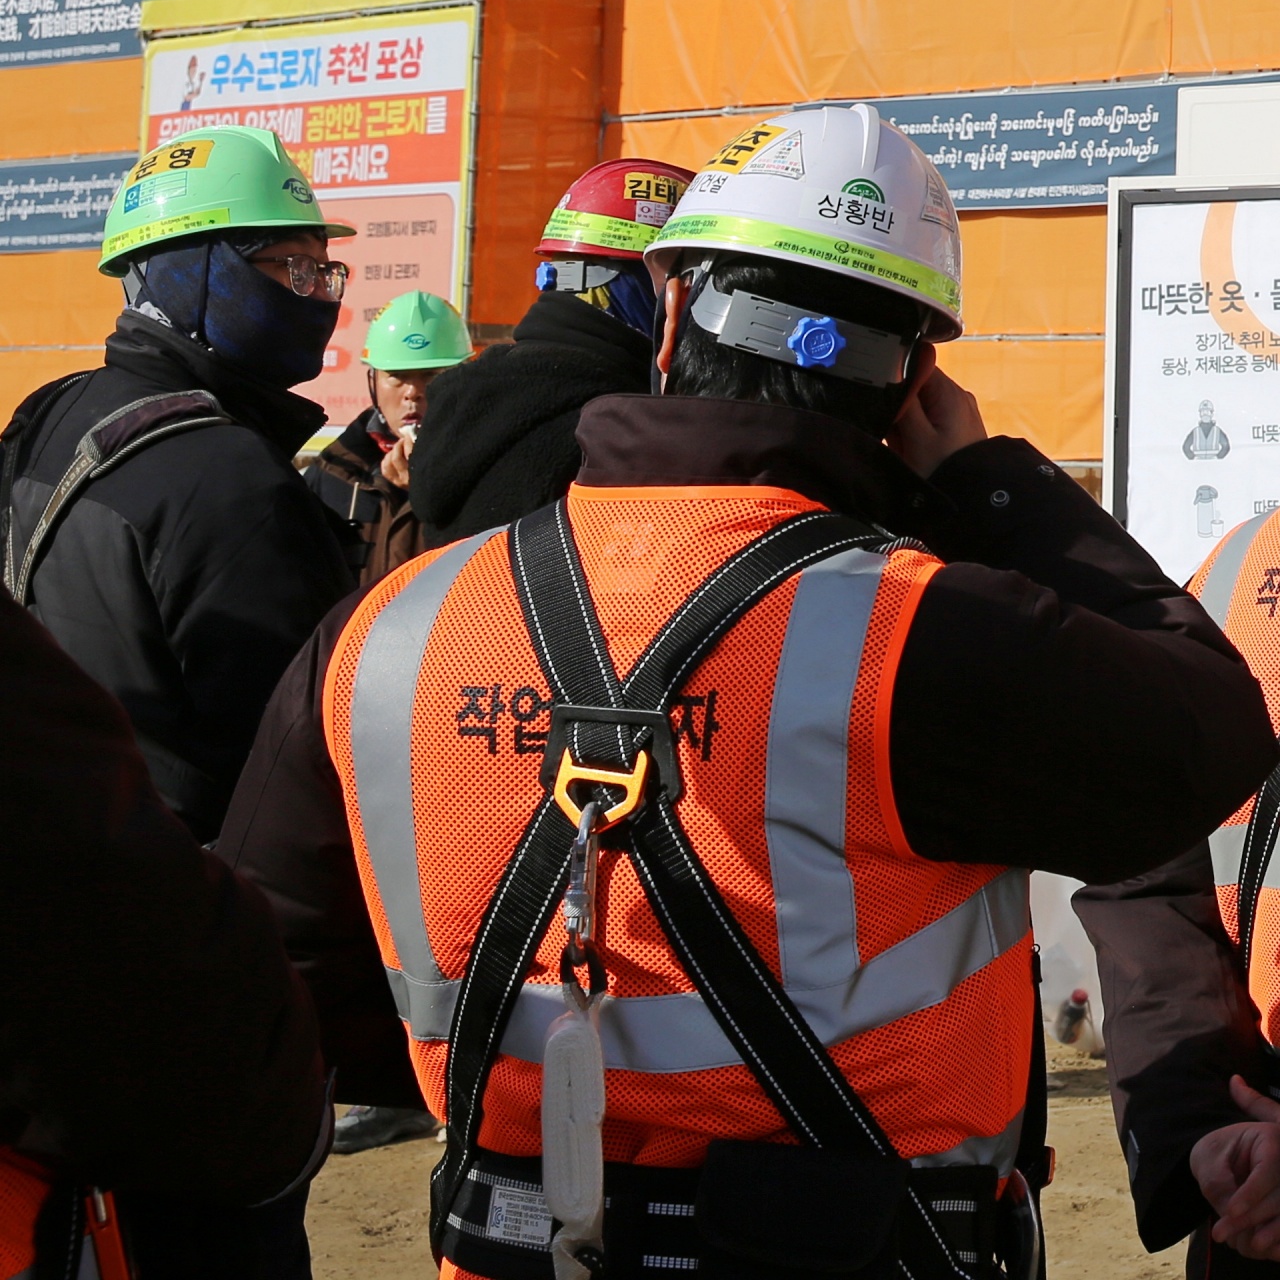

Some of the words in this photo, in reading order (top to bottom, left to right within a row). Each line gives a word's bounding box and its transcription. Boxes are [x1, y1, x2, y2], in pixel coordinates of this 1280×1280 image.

[210, 46, 322, 94] 우수근로자
[326, 41, 370, 85] 추천
[375, 37, 424, 80] 포상
[306, 101, 363, 143] 공헌한
[366, 95, 448, 139] 근로자를
[628, 178, 684, 204] 김태
[817, 193, 896, 236] 상황반
[773, 239, 850, 267] 대전하수처리장시설
[852, 259, 876, 274] 현대화
[1141, 282, 1213, 317] 따뜻한
[1219, 279, 1245, 314] 옷
[1195, 333, 1236, 351] 장기간
[1238, 330, 1267, 350] 추위
[1161, 357, 1192, 377] 동상,
[1194, 355, 1249, 374] 저체온증
[1251, 353, 1279, 373] 등에
[455, 683, 719, 762] 작업자
